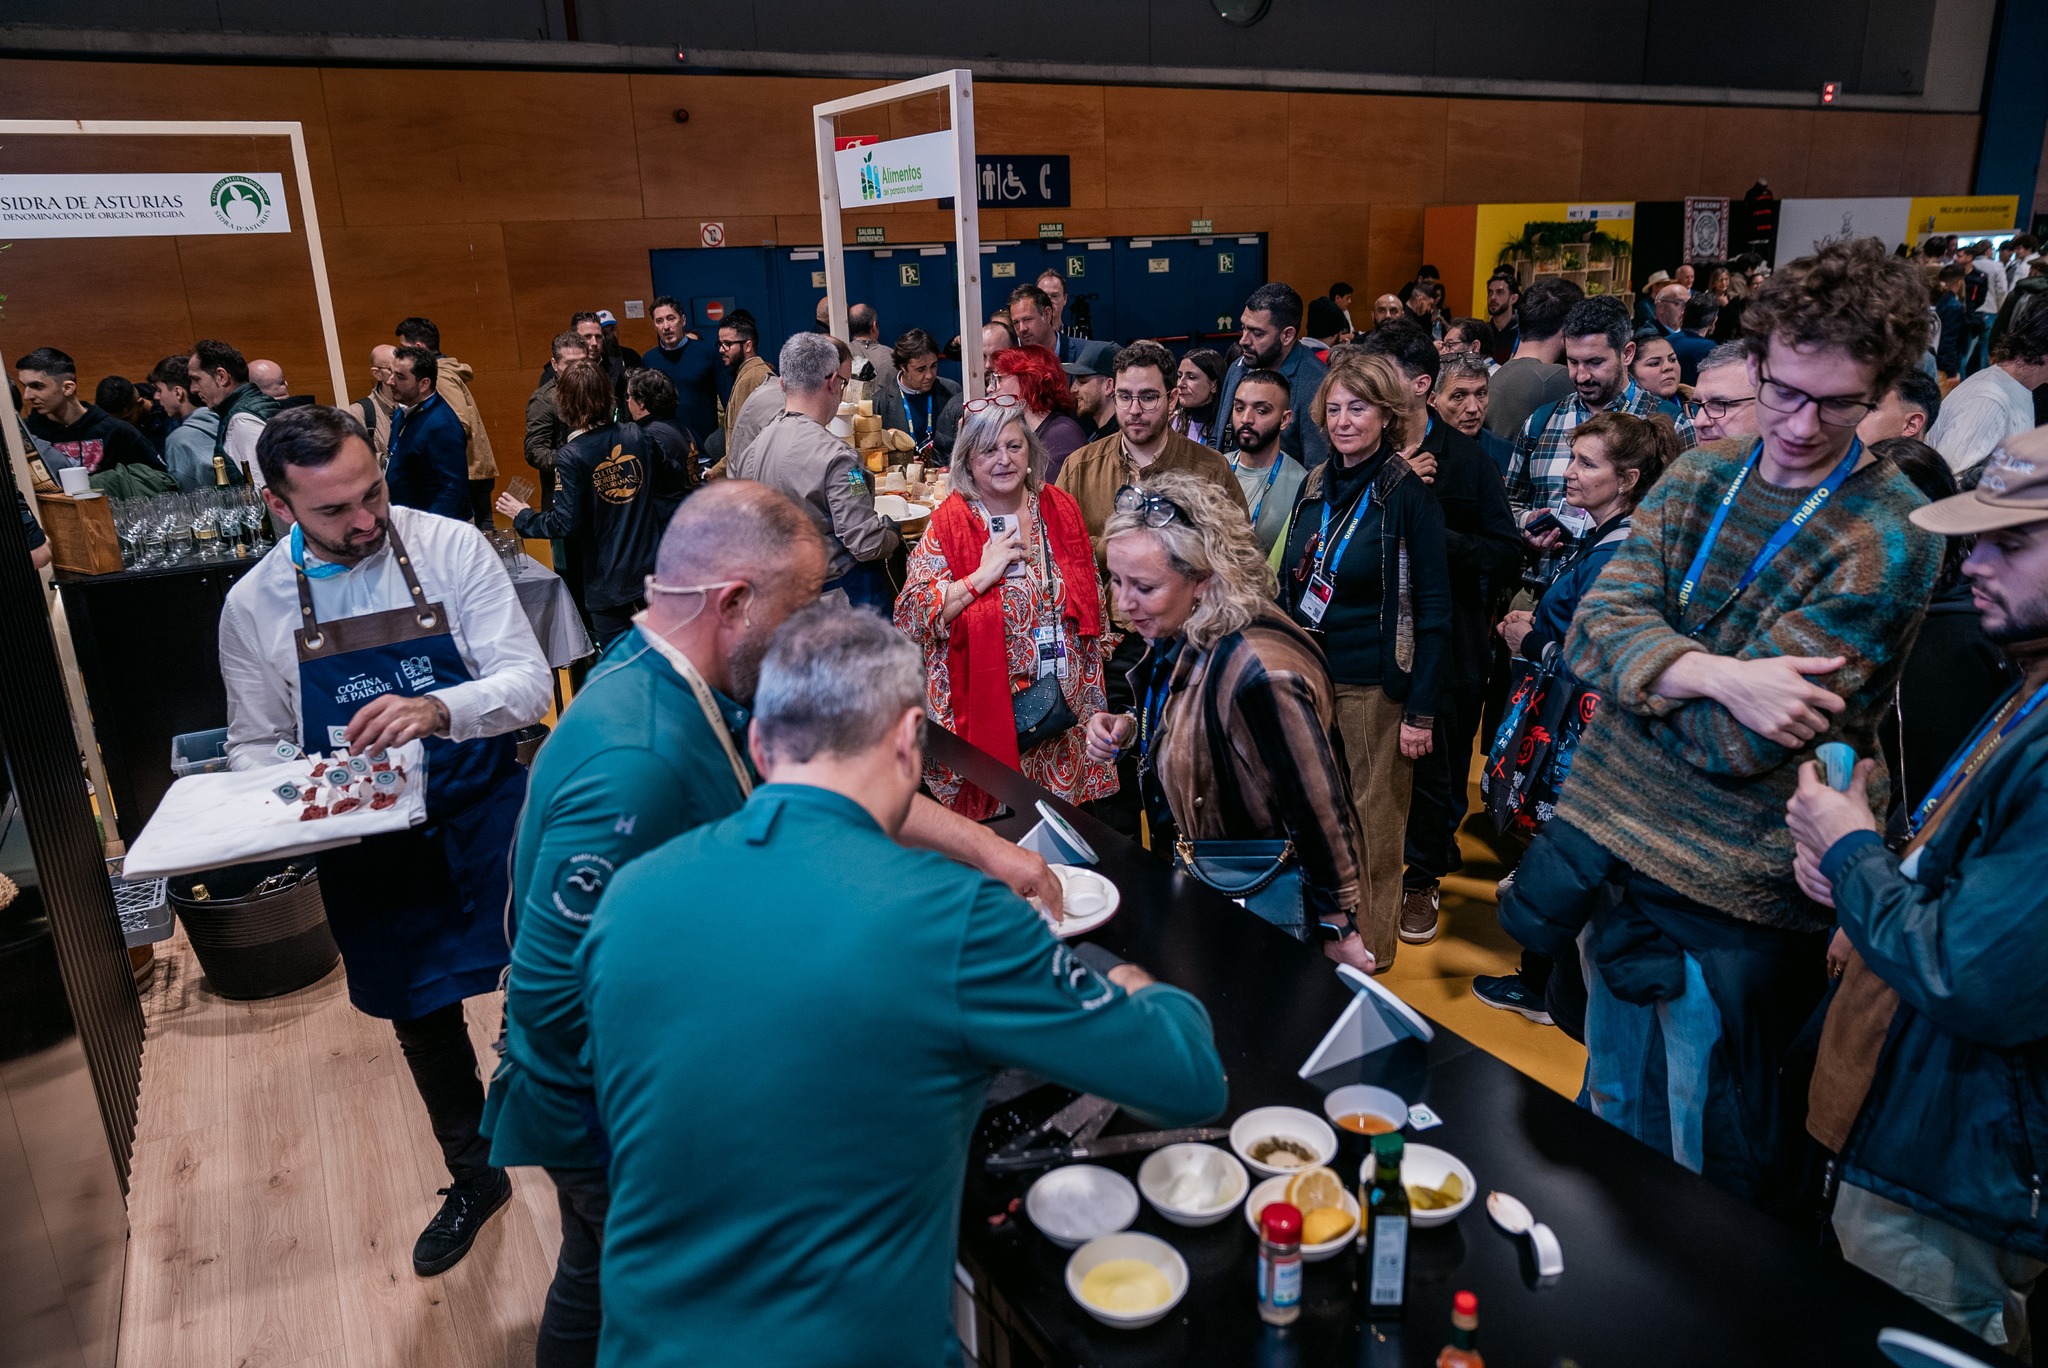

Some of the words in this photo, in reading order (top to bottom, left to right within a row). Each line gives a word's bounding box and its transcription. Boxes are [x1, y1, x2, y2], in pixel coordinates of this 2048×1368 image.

[882, 165, 922, 184] Alimentos
[907, 183, 923, 193] natural
[1, 196, 62, 210] SIDRA
[65, 196, 90, 209] DE
[94, 195, 183, 209] ASTURIAS
[3, 212, 83, 221] DENOMINACION
[98, 211, 134, 219] ORIGEN
[135, 210, 185, 219] PROTEGIDA
[214, 210, 235, 230] SIDRA
[857, 235, 884, 243] EMERGENCIA
[592, 464, 624, 480] CULTURA
[593, 474, 622, 487] SIDRERA
[597, 477, 630, 493] ASTURIANA
[1723, 466, 1749, 506] makro
[1791, 487, 1830, 527] makro
[1344, 517, 1359, 540] makro
[335, 694, 350, 704] DE
[350, 682, 393, 702] PAISAJE
[337, 676, 382, 695] COCINA
